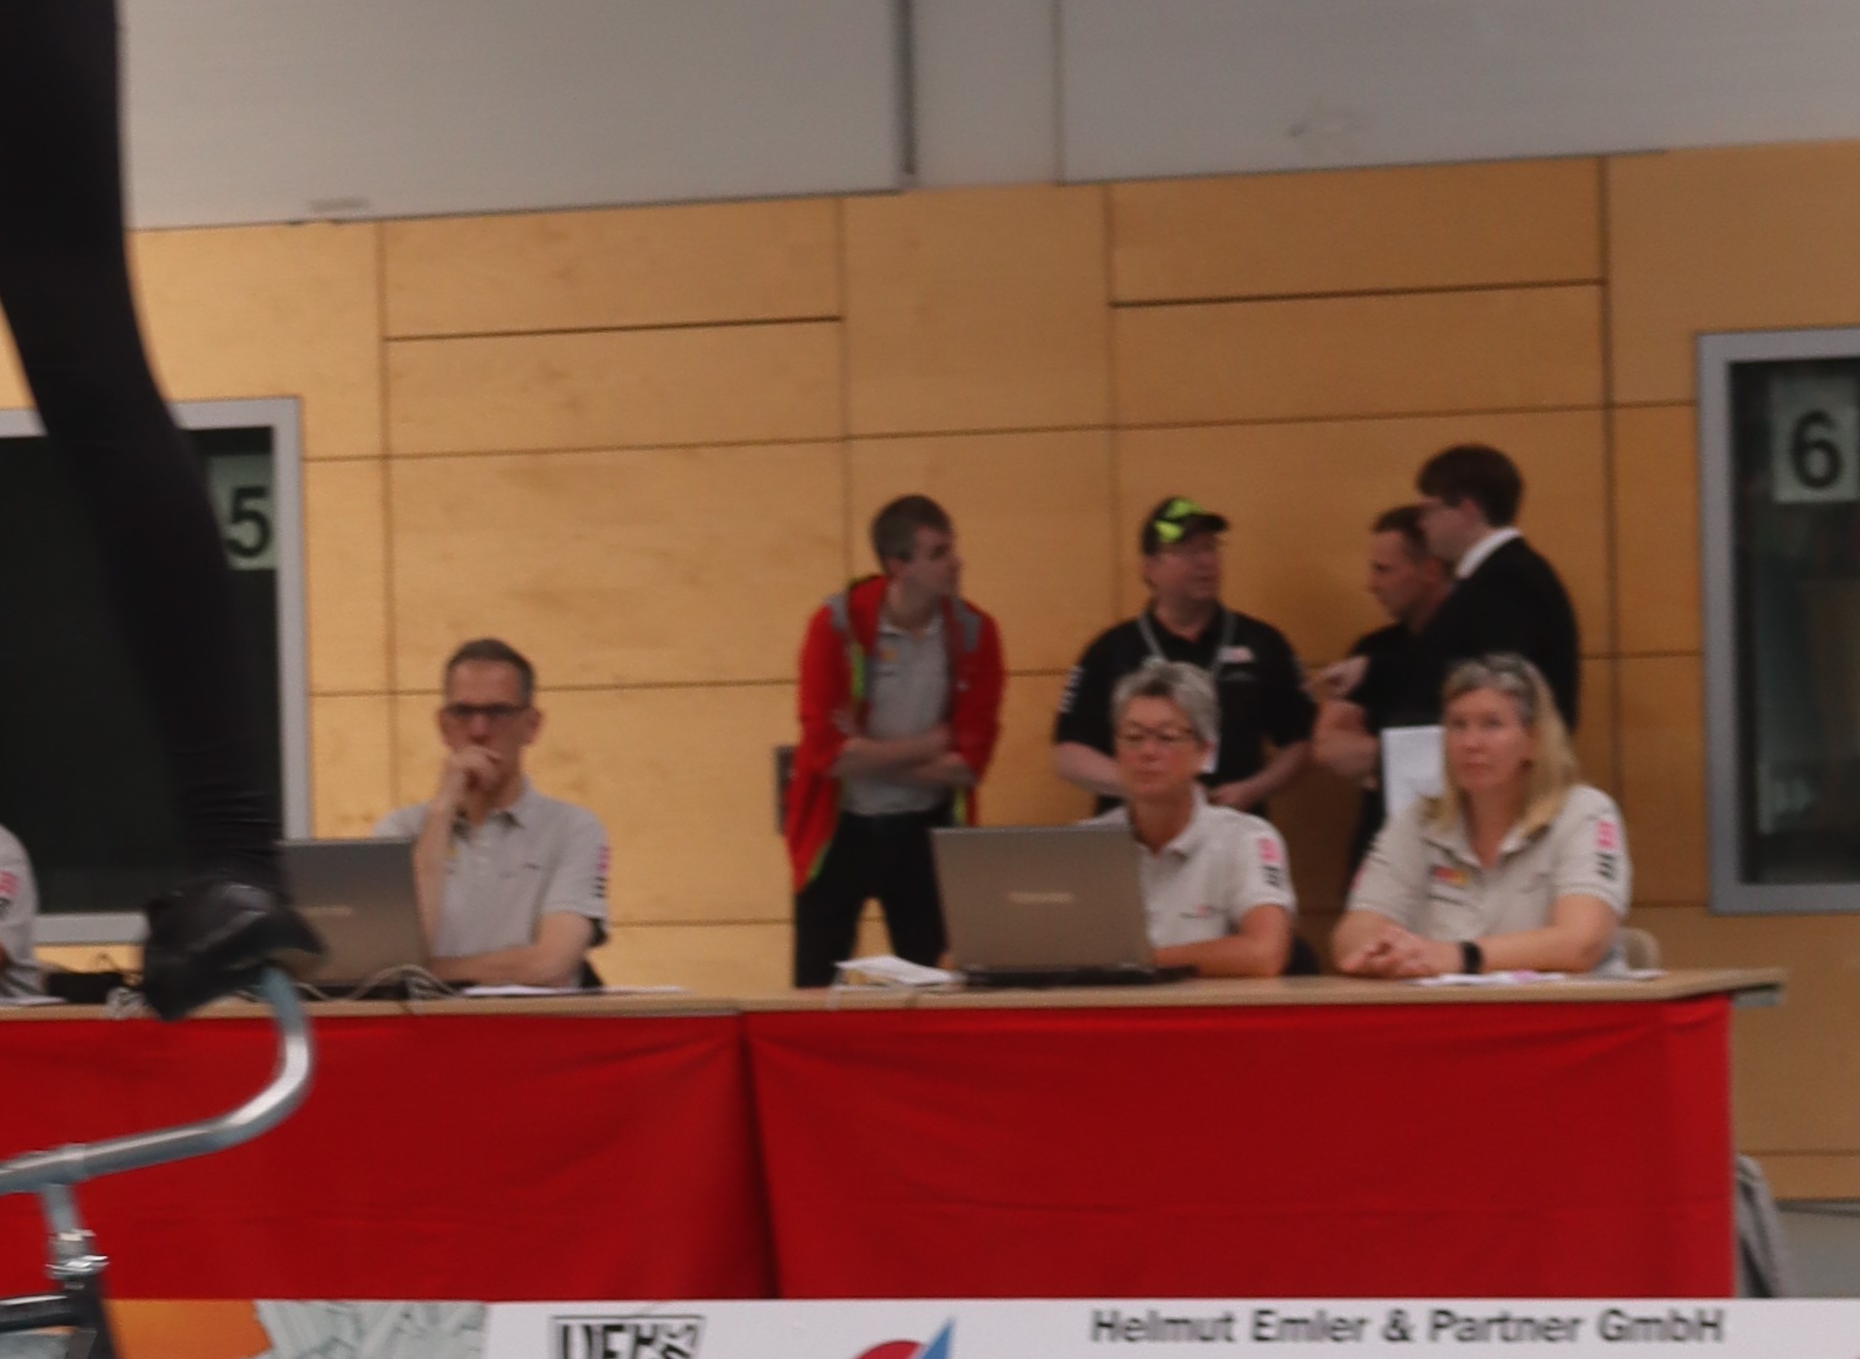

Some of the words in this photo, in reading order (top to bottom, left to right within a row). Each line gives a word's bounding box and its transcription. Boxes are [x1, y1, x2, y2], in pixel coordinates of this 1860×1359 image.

[1790, 410, 1844, 490] 6
[225, 486, 271, 559] 5
[1089, 1311, 1236, 1342] Helmut
[1250, 1310, 1367, 1342] Emler
[1382, 1310, 1414, 1342] &
[1426, 1309, 1581, 1342] Partner
[1596, 1309, 1724, 1342] GmbH
